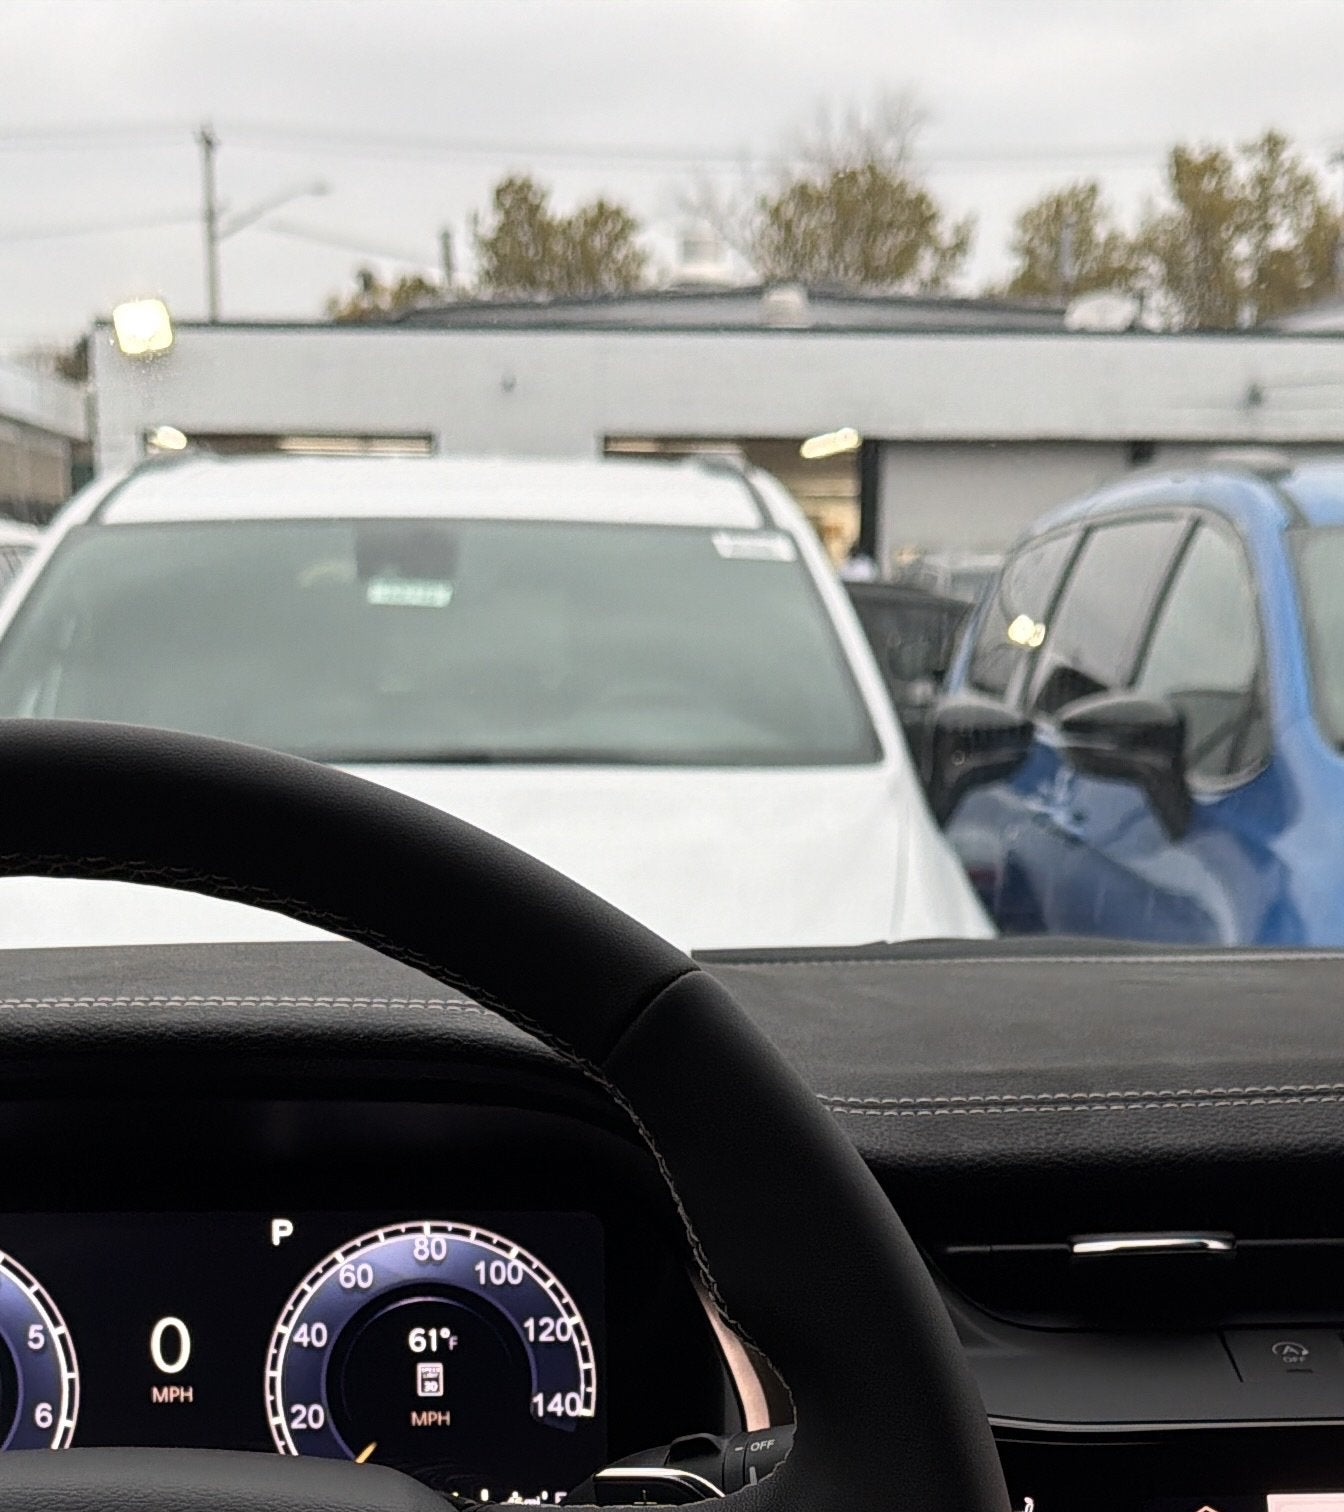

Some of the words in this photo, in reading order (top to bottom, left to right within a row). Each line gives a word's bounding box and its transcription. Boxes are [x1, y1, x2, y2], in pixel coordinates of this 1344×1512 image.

[271, 1219, 294, 1246] P
[413, 1237, 446, 1261] 80
[339, 1263, 374, 1289] 60
[475, 1260, 523, 1286] 100
[27, 1324, 45, 1350] 5
[293, 1323, 328, 1348] 40
[524, 1316, 571, 1342] 120
[149, 1316, 191, 1374] 0
[152, 1386, 194, 1404] MPH
[532, 1392, 580, 1418] 140
[34, 1402, 53, 1429] 6
[290, 1404, 325, 1430] 20
[411, 1410, 451, 1427] MPH
[750, 1438, 775, 1452] OFF
